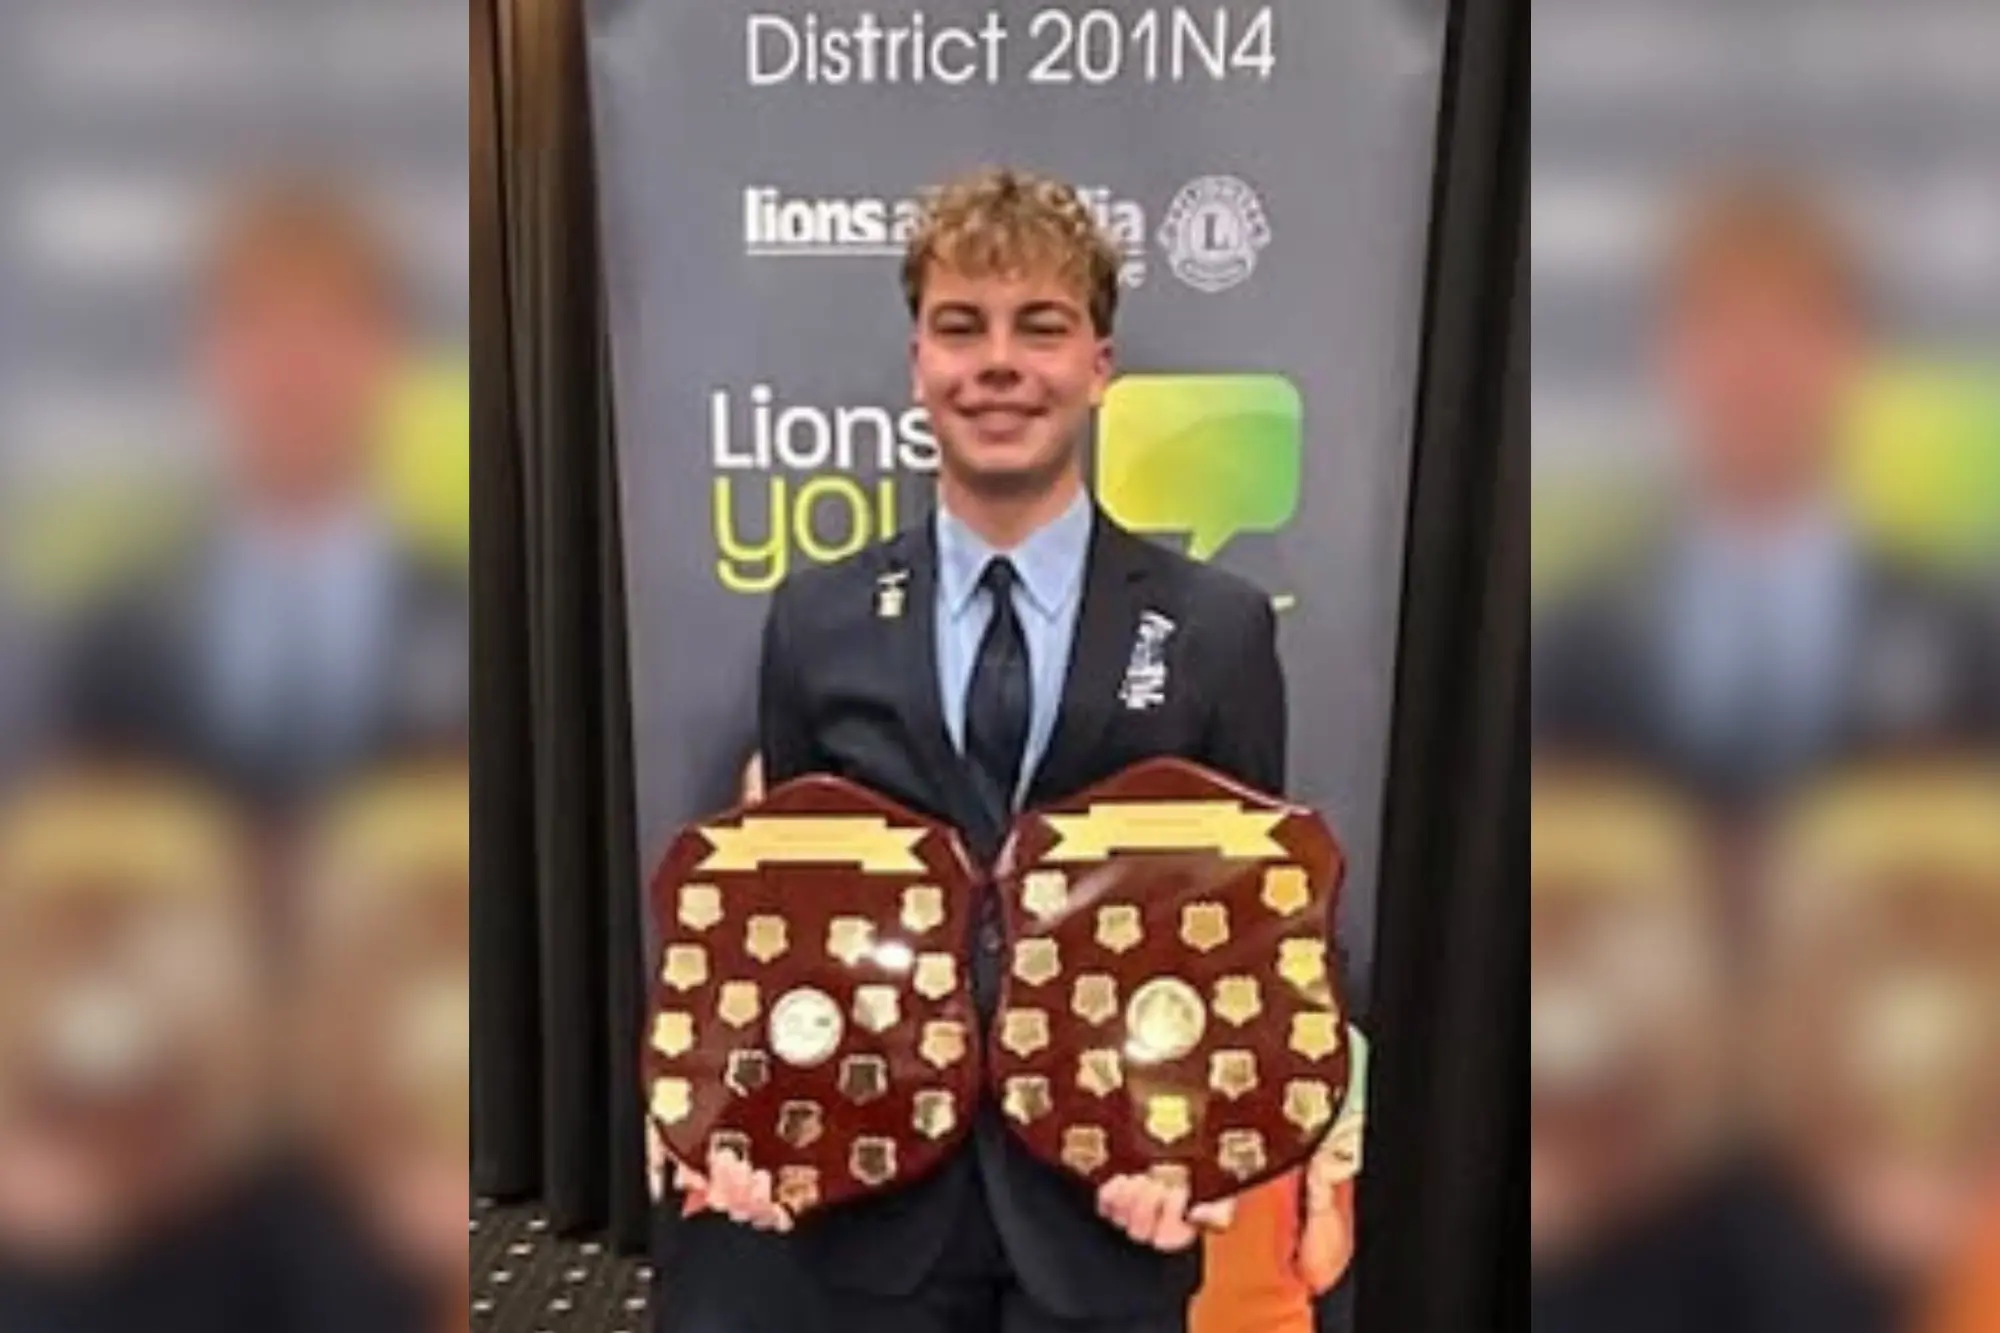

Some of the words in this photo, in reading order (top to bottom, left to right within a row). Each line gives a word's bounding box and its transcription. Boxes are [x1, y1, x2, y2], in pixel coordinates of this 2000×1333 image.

[747, 11, 1007, 86] District
[1029, 7, 1276, 83] 201N4
[712, 384, 941, 470] Lions
